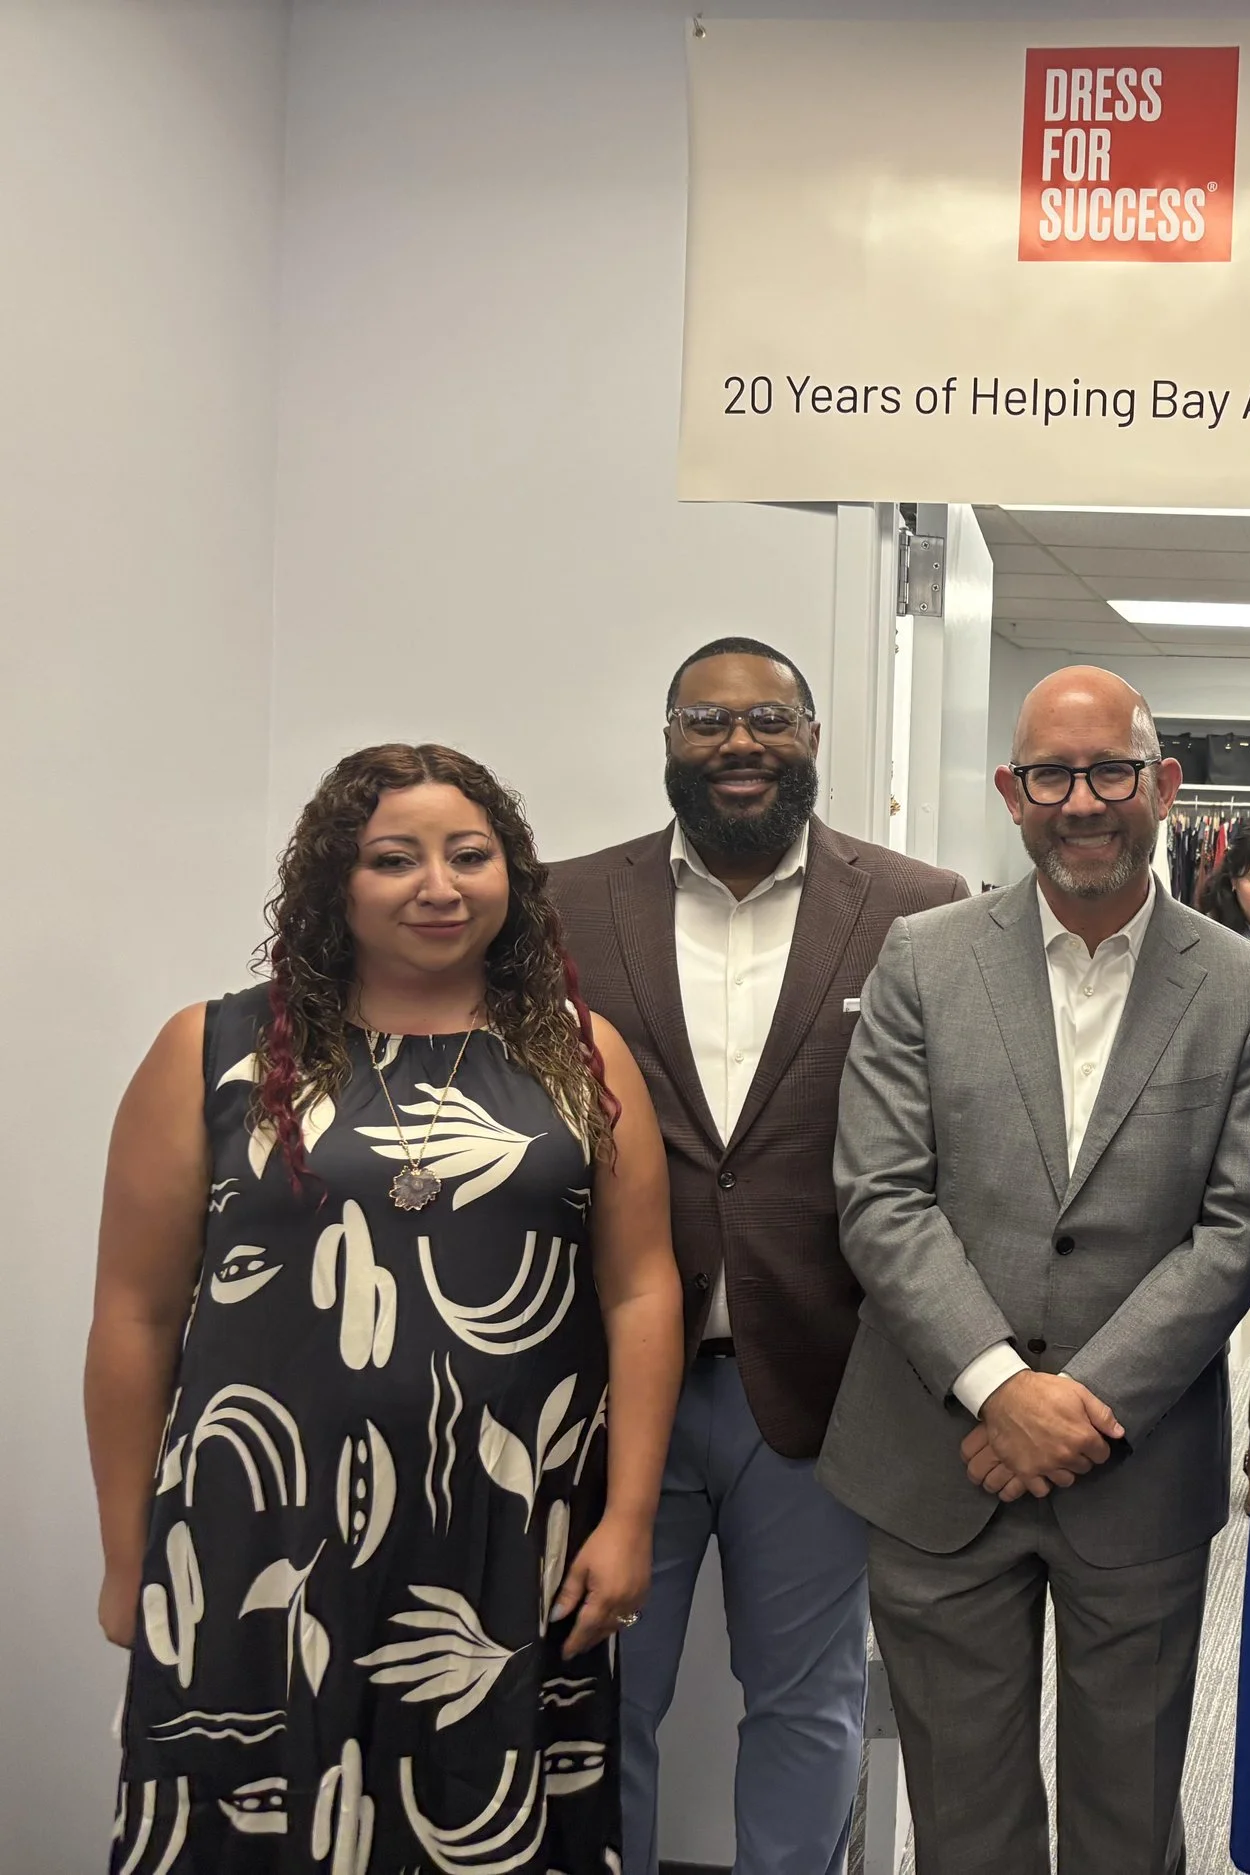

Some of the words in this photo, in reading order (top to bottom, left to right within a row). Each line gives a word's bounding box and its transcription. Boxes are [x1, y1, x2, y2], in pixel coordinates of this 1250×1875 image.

[1044, 67, 1163, 122] DRESS
[1041, 128, 1111, 182] FOR
[723, 376, 774, 415] 20
[786, 375, 902, 414] Years
[915, 377, 958, 414] of
[971, 377, 1136, 428] Helping
[1151, 380, 1231, 430] Bay
